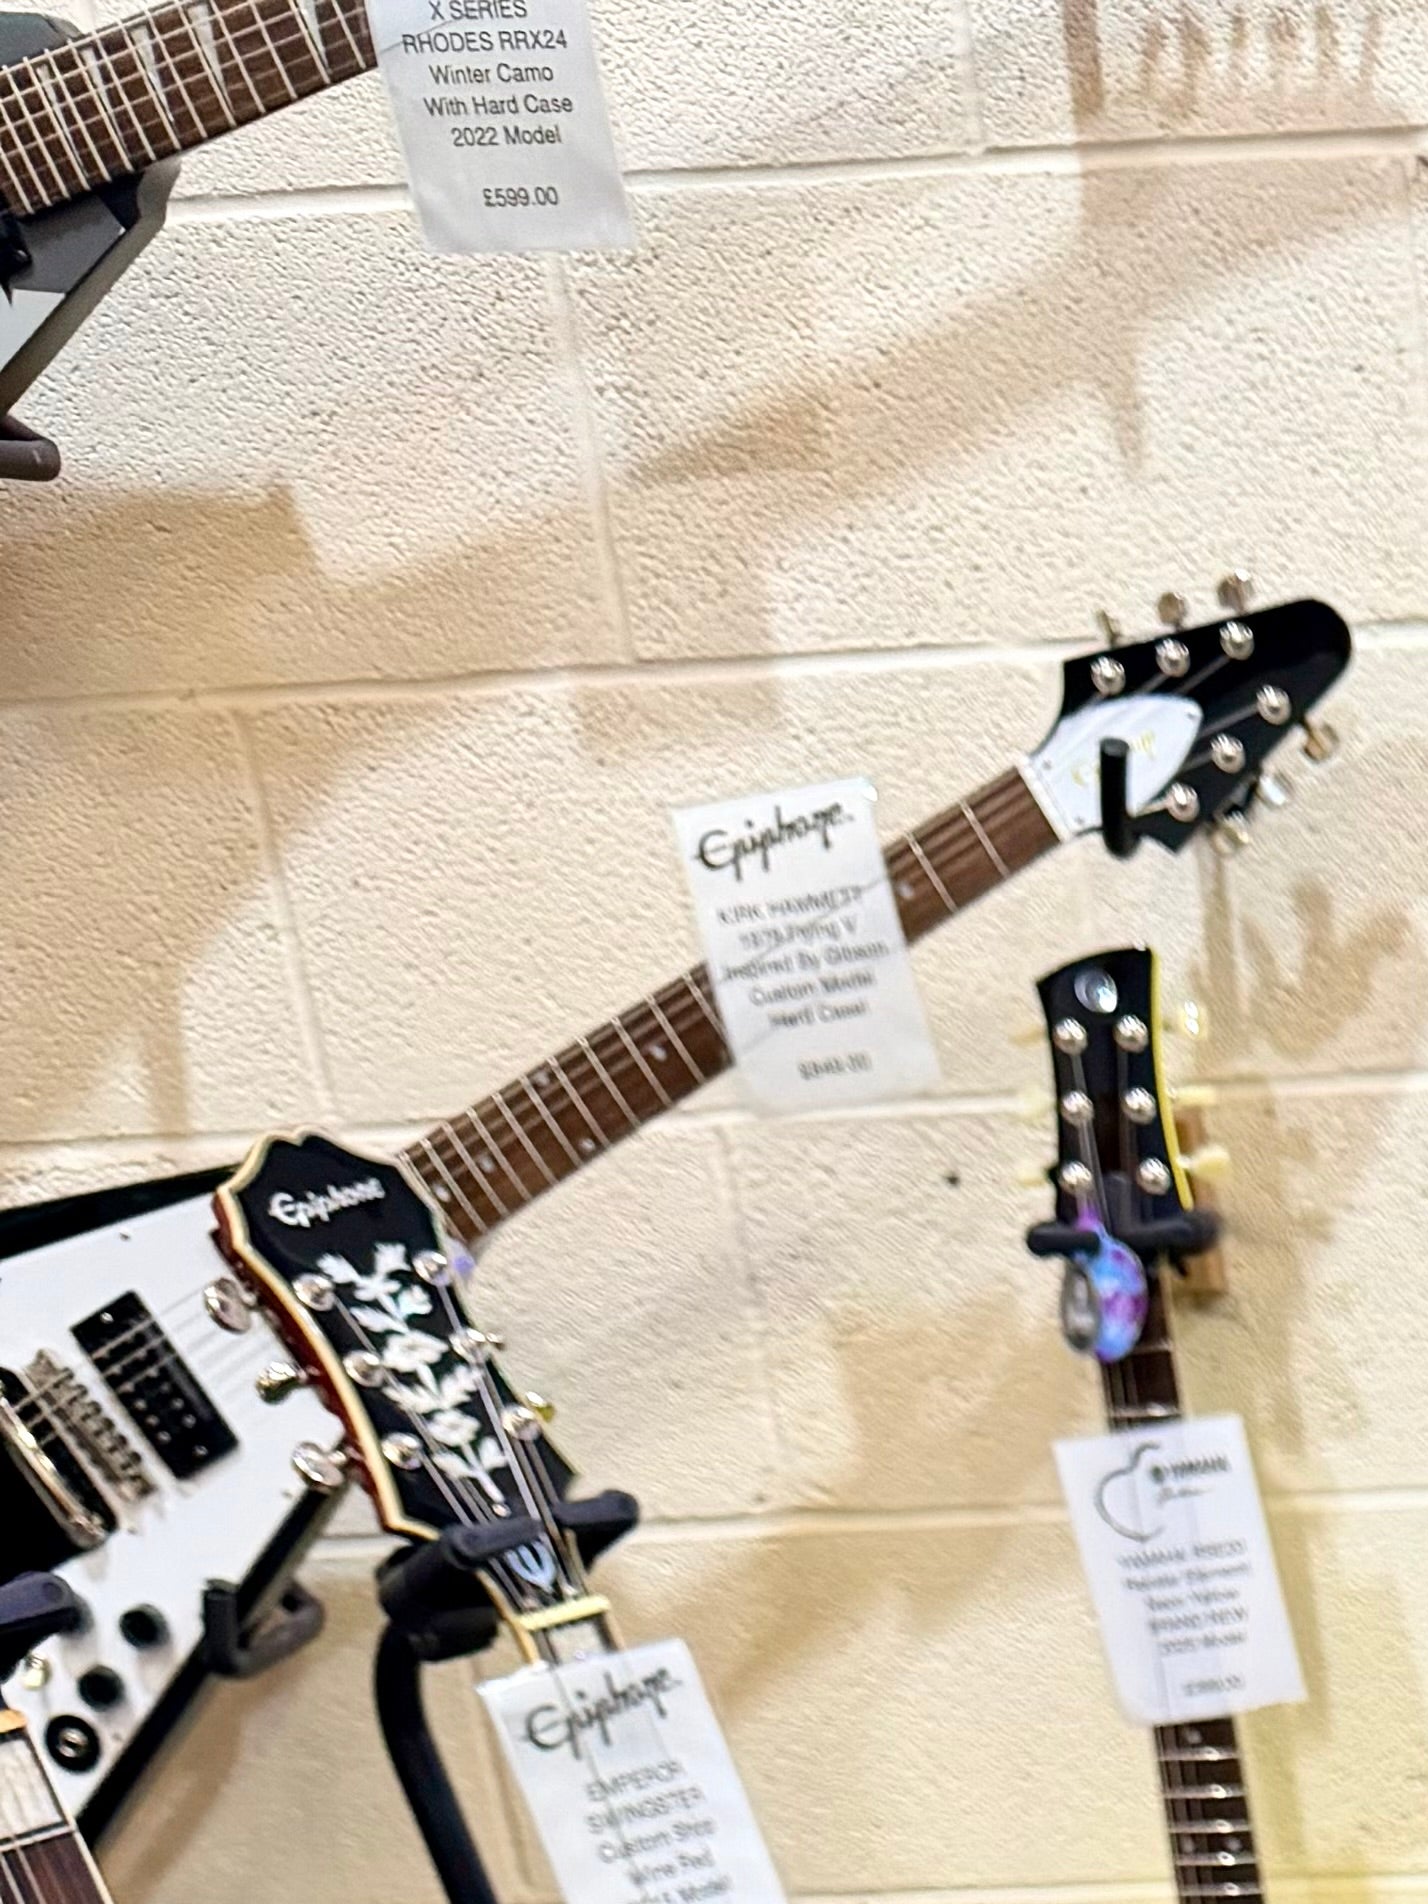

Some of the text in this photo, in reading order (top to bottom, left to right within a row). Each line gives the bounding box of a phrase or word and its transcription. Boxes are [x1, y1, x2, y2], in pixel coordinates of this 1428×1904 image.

[430, 0, 528, 20] X SERIES
[401, 29, 568, 54] RHODES RRX24
[429, 62, 555, 85] Winter Camo
[423, 94, 574, 117] With Hard Case
[450, 124, 563, 147] 2022 Model
[482, 187, 559, 207] £599.00
[693, 801, 854, 883] Epiphone
[520, 1667, 684, 1760] Epiphone
